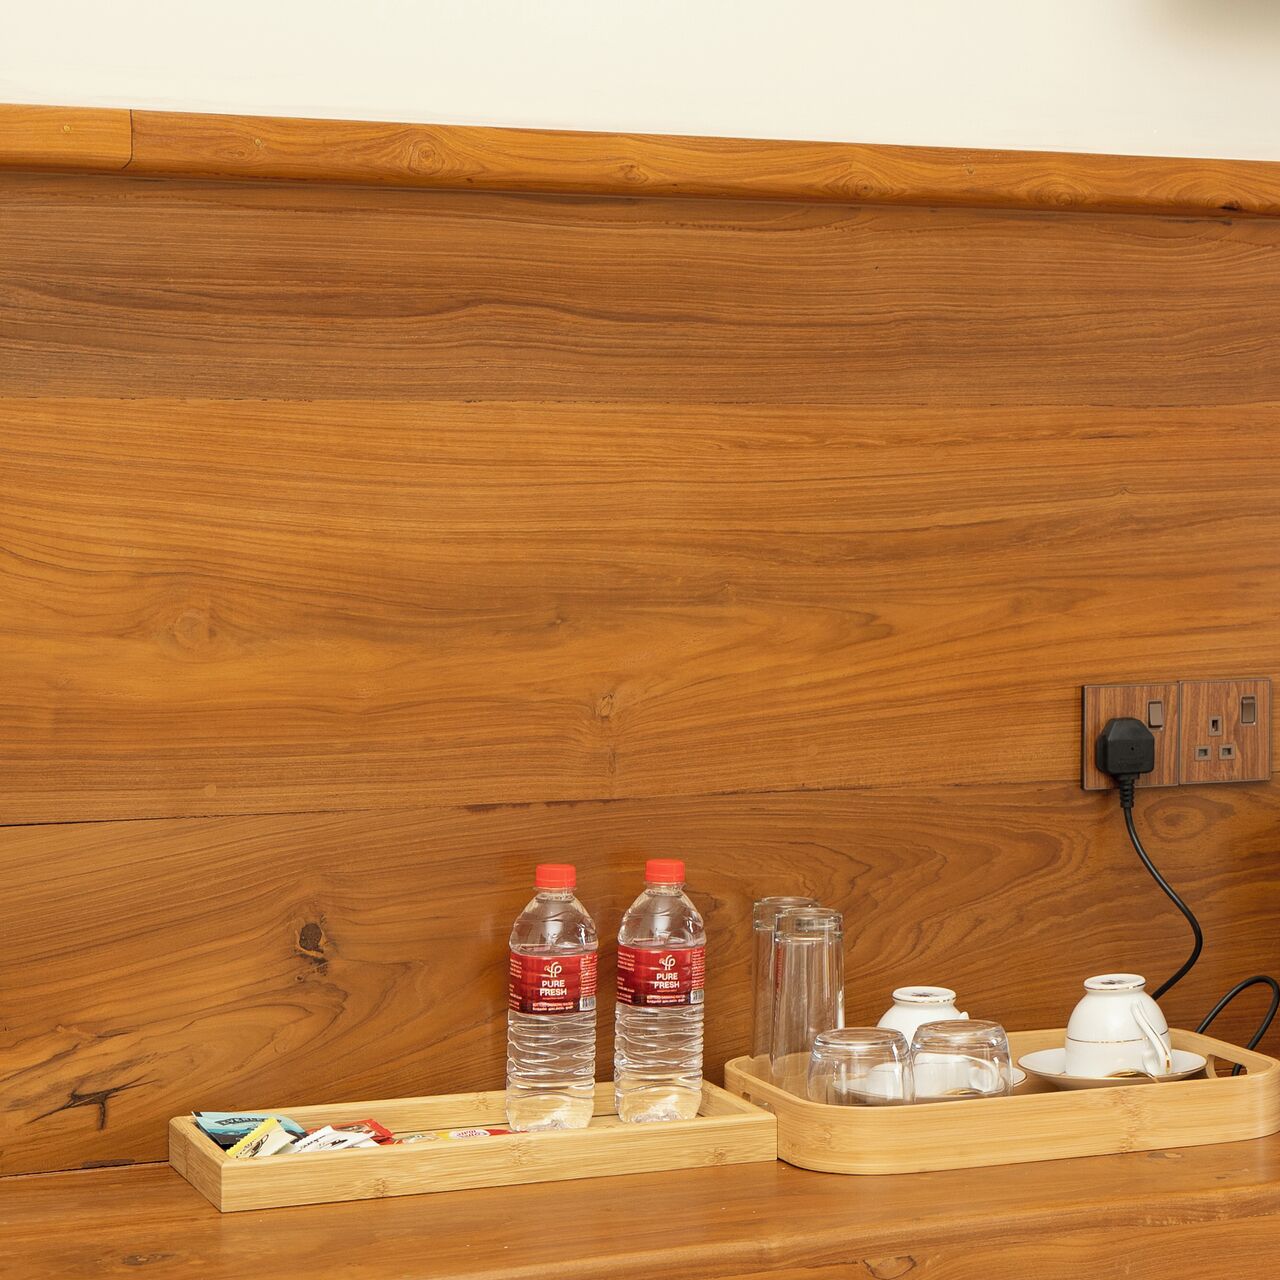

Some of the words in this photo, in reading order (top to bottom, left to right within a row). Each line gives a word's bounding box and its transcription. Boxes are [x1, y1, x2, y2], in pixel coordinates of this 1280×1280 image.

[656, 972, 678, 981] PURE
[541, 980, 565, 988] PURE
[654, 981, 680, 989] FRESH
[539, 988, 567, 996] FRESH
